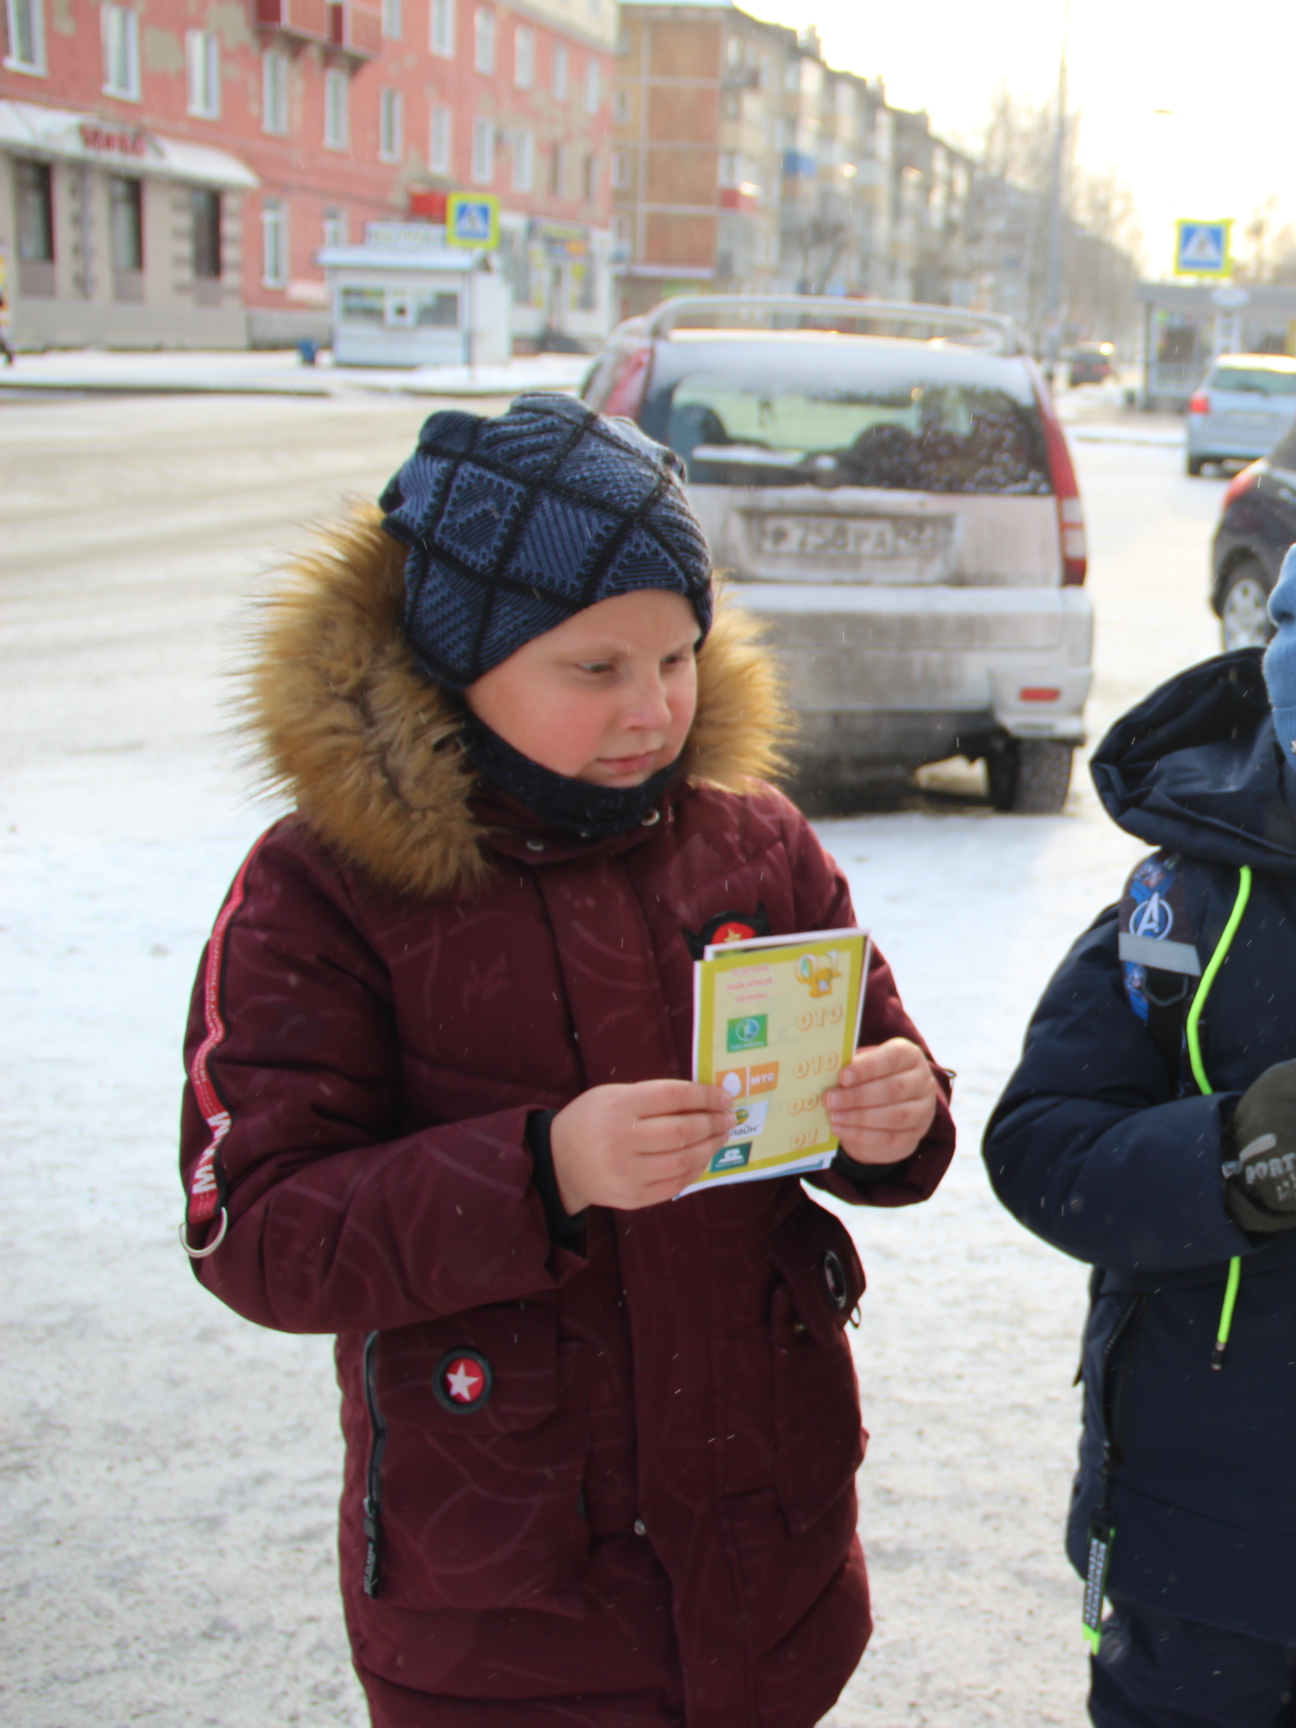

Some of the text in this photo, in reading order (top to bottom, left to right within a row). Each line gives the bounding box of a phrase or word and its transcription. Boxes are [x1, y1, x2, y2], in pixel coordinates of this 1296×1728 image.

[795, 1003, 844, 1032] 010
[793, 1052, 839, 1079] 010
[751, 1072, 776, 1086] МТС
[787, 1093, 823, 1116] 00
[728, 1124, 757, 1137] лайн
[789, 1128, 819, 1150] 01
